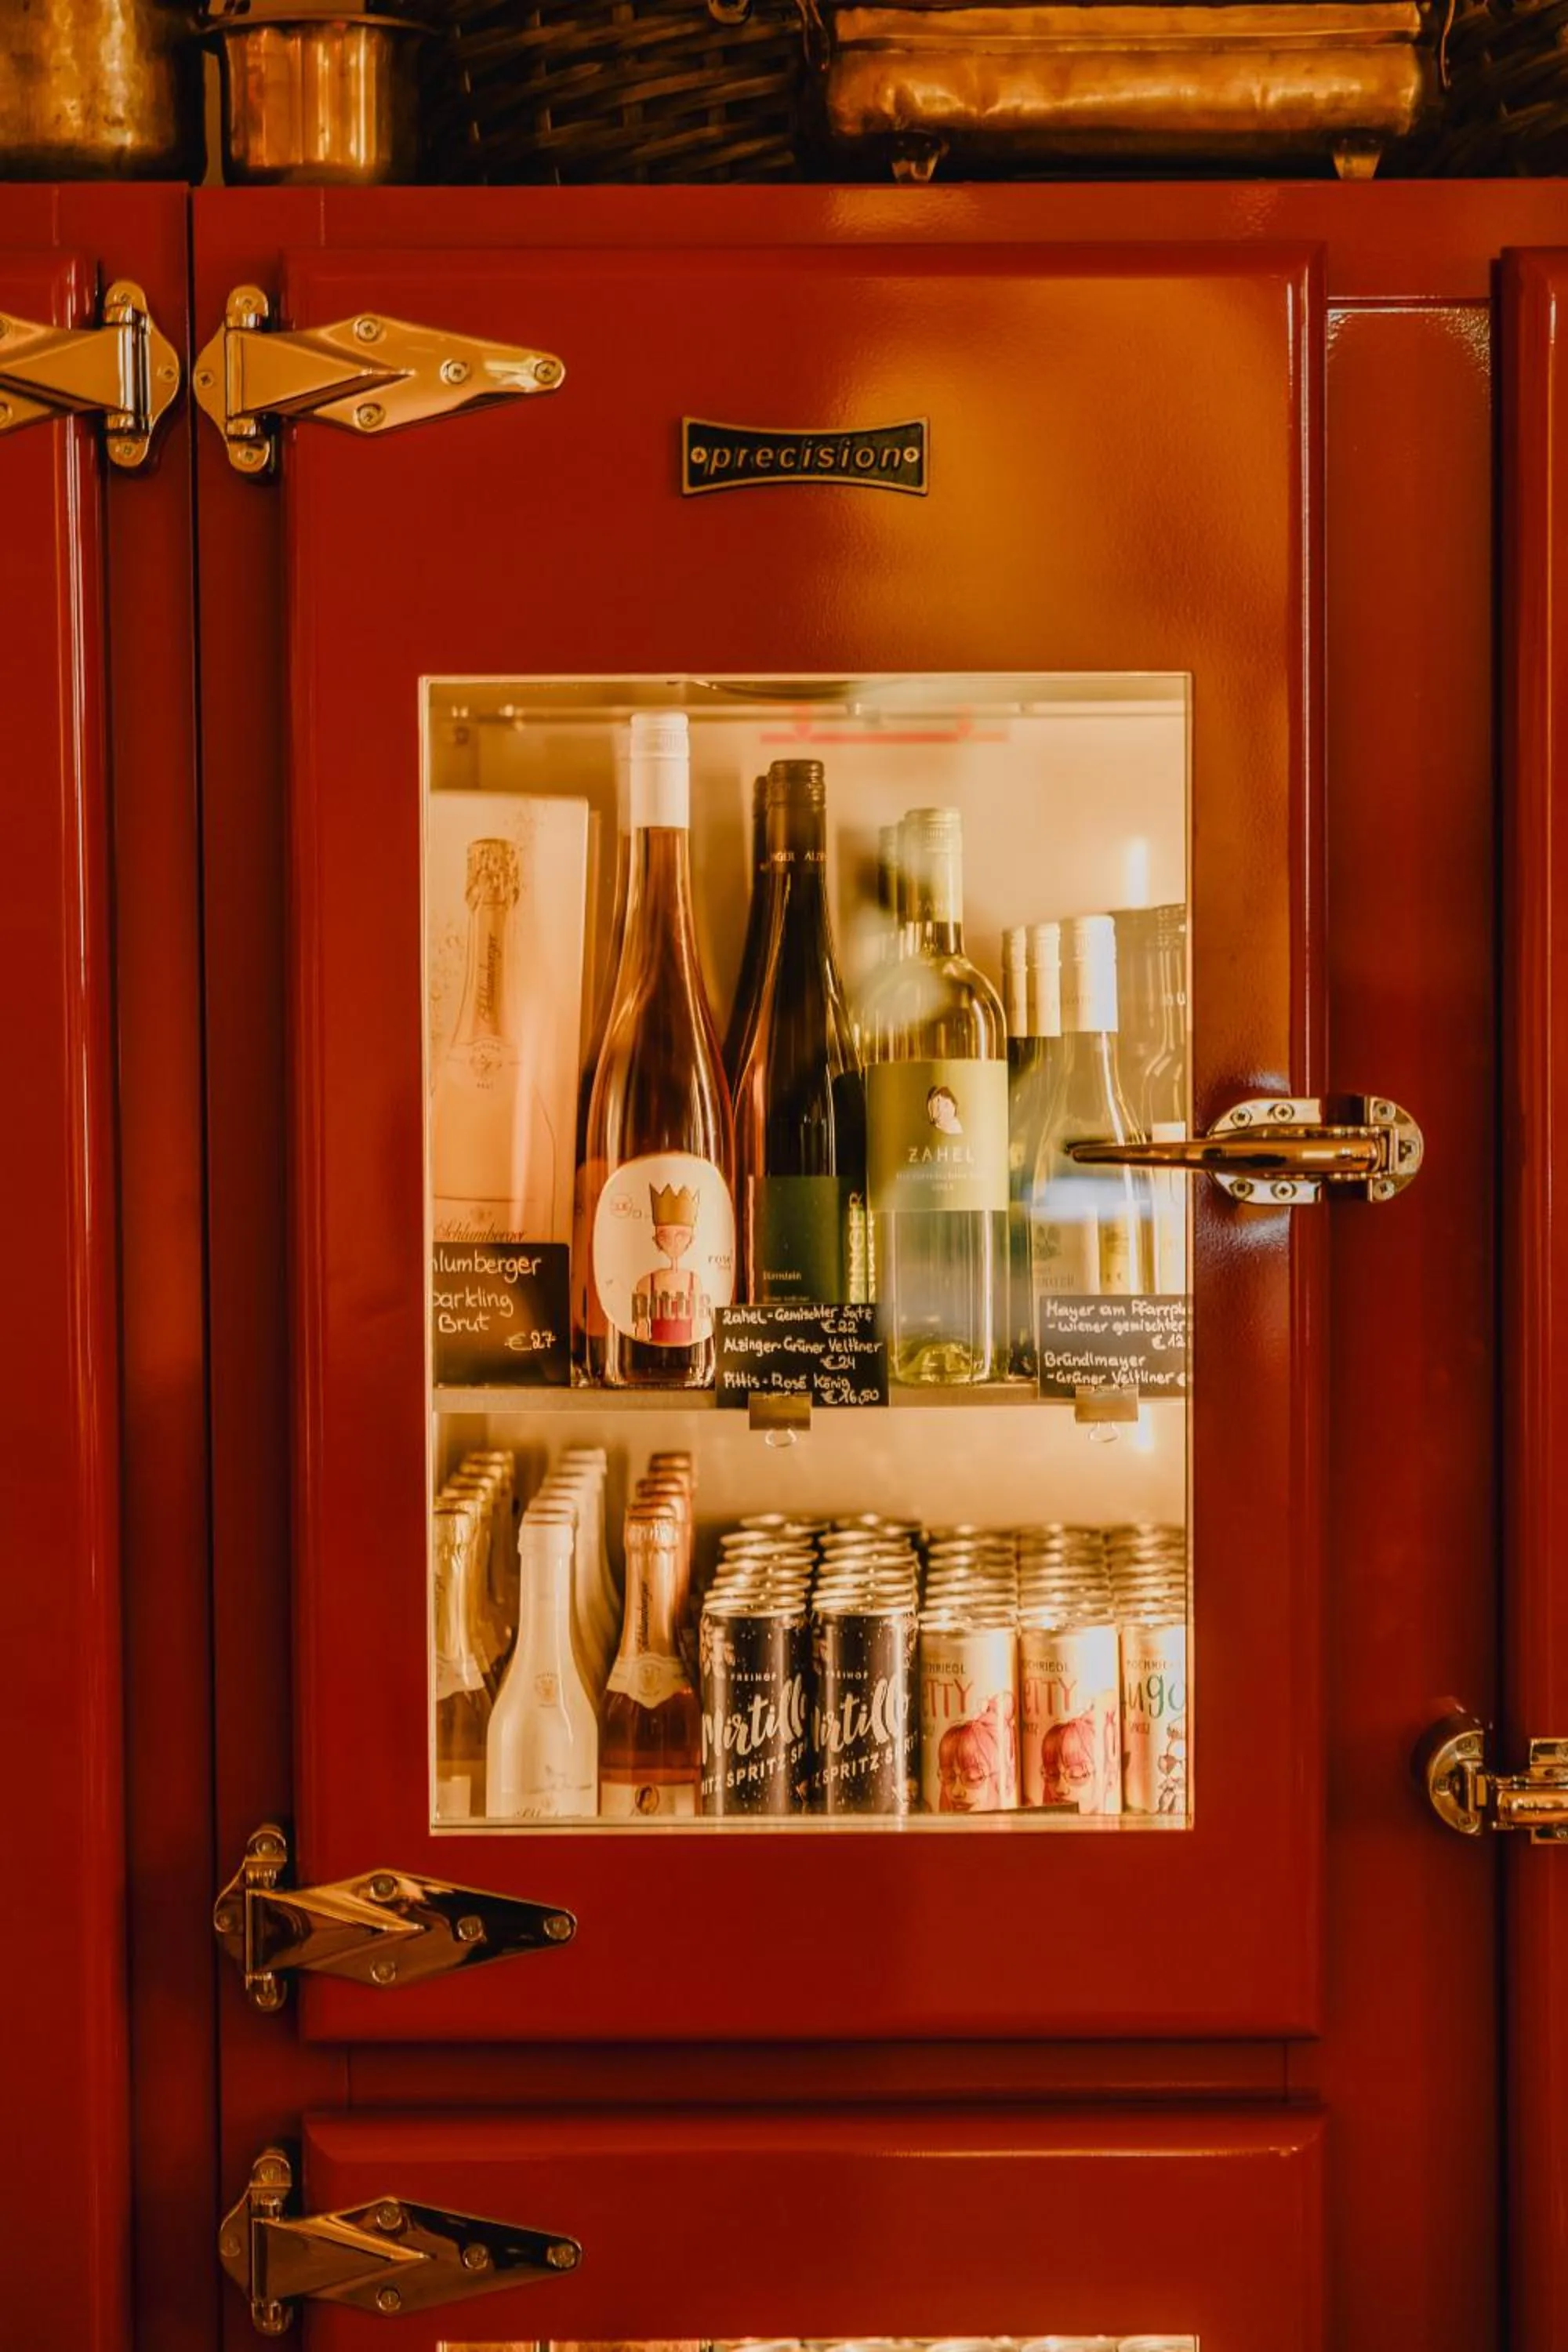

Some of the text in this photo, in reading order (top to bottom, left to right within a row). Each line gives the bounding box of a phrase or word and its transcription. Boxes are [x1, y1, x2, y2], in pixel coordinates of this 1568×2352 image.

[710, 441, 901, 475] precision
[909, 1145, 974, 1163] ZAHEL
[438, 1310, 491, 1333] Brut
[1100, 1305, 1126, 1316] am
[726, 1754, 787, 1788] SPRITZ
[822, 1752, 880, 1785] SPRITZ
